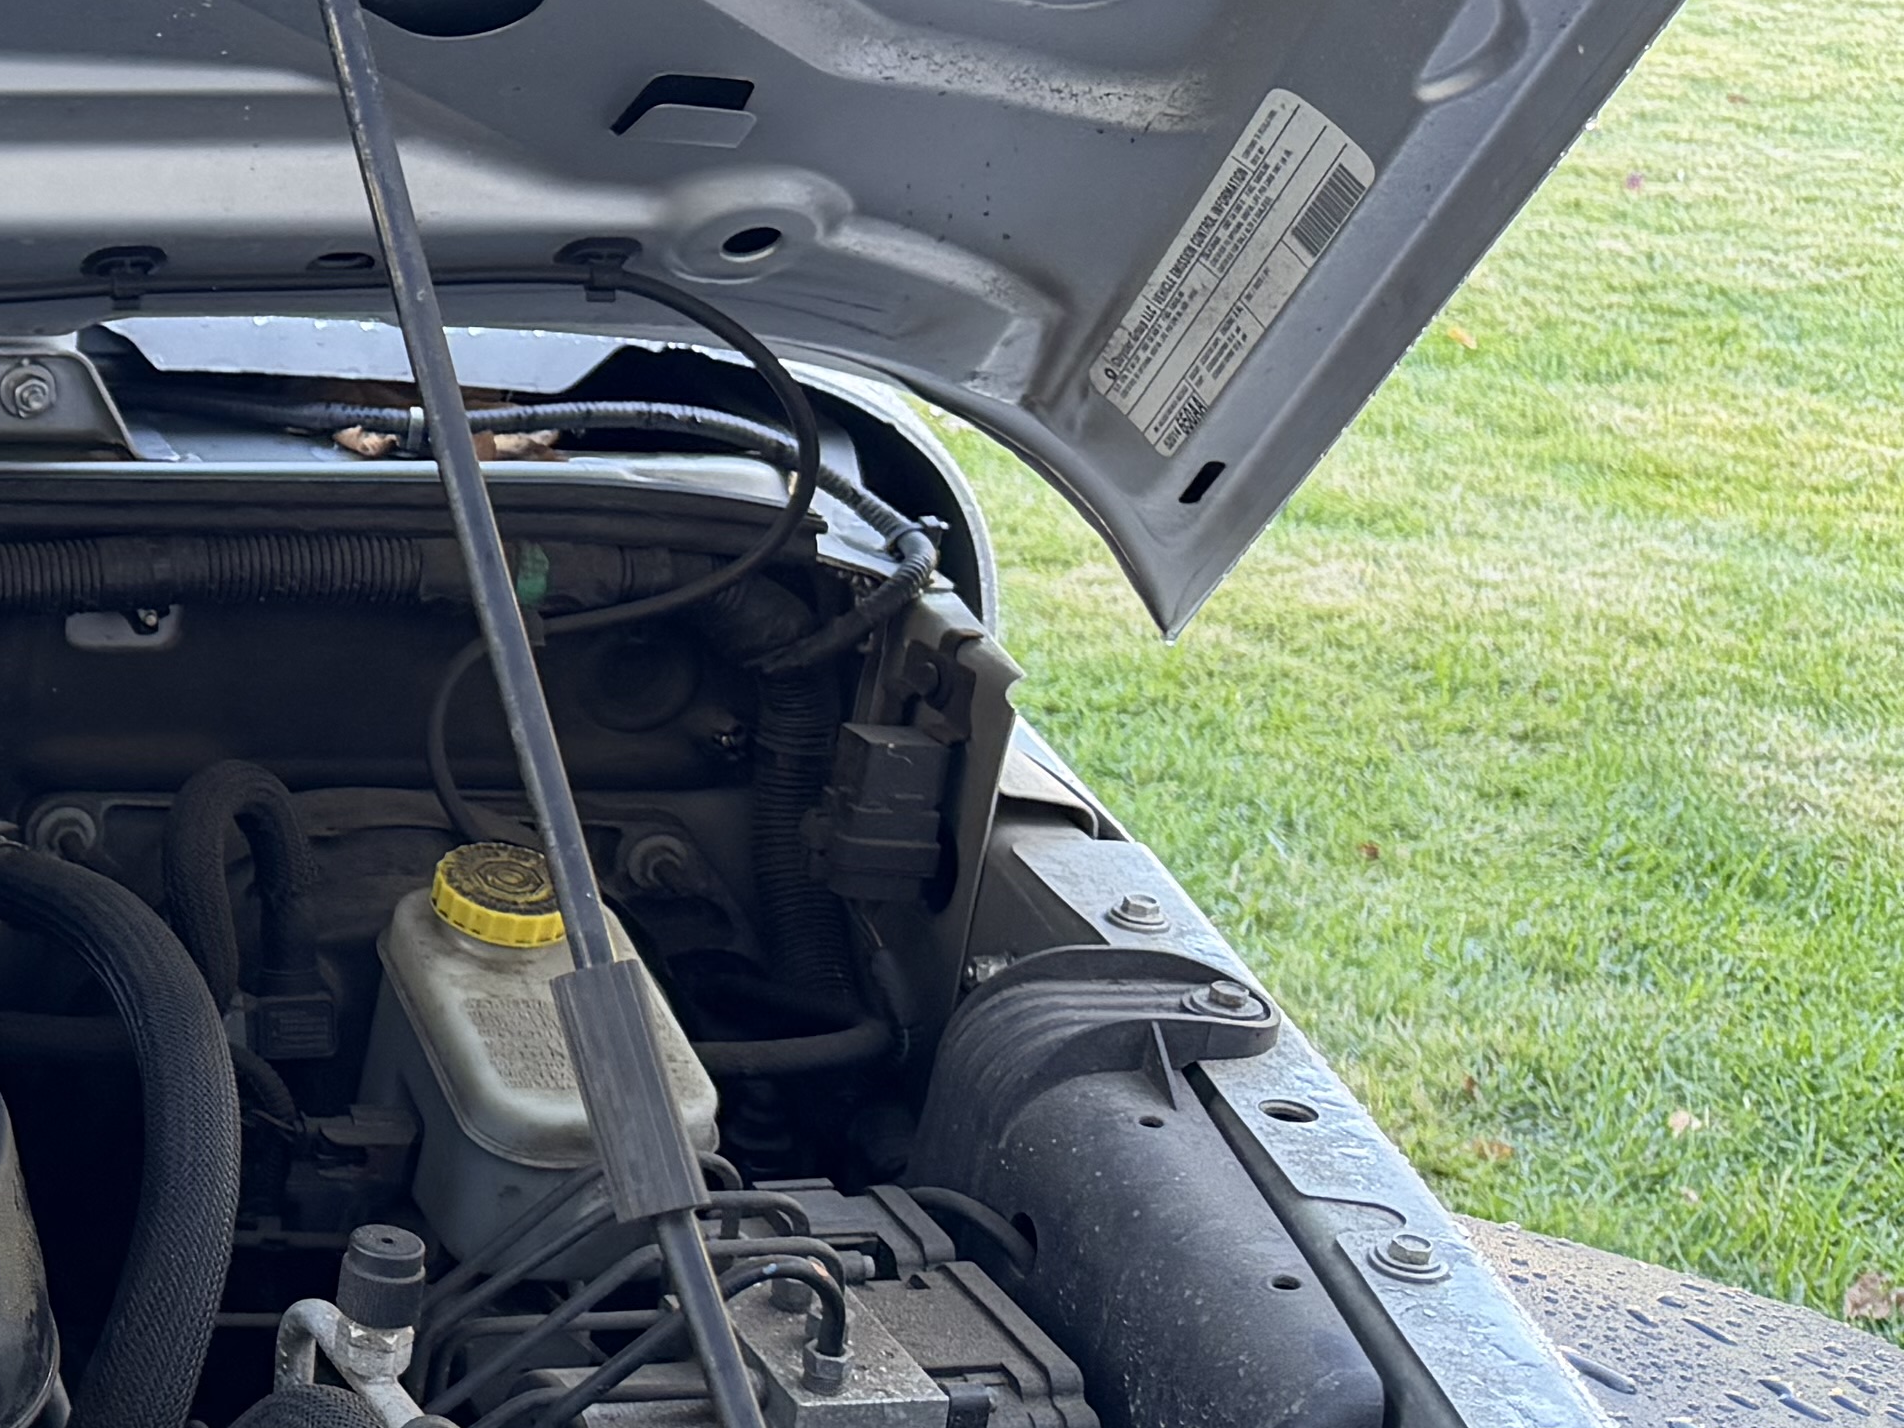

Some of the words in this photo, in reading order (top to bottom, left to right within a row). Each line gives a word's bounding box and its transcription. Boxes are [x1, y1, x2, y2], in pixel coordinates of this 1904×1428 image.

[1150, 271, 1177, 307] VEHICLE
[1168, 240, 1197, 280] EMISSION
[1188, 209, 1219, 249] CONTROL
[1209, 163, 1249, 219] INFORMATION
